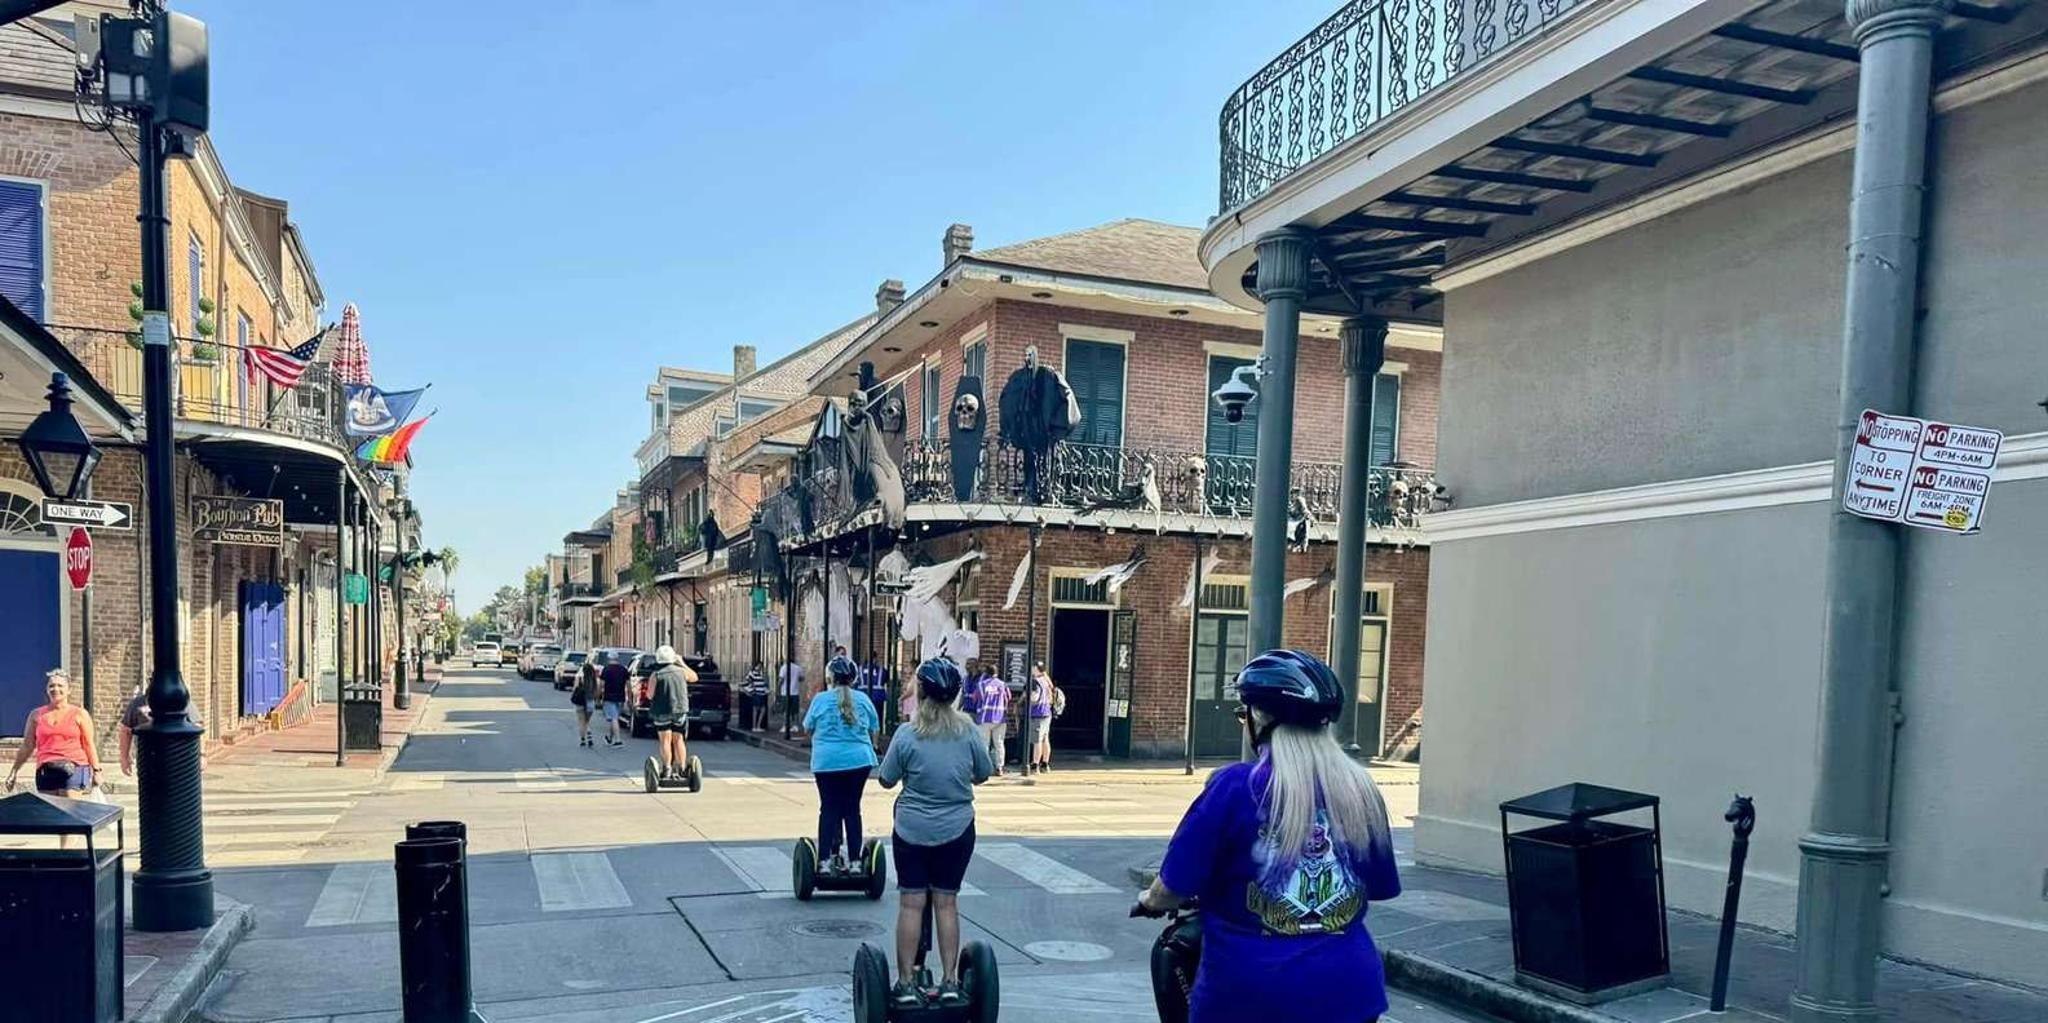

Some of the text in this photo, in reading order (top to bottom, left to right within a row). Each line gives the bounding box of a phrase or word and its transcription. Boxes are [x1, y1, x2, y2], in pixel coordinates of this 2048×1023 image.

[1861, 417, 1919, 444] NO STOPPING
[1926, 429, 1996, 448] NO PARKING
[1871, 451, 1887, 463] TO
[1934, 450, 1983, 464] 4PM-6AM
[1855, 462, 1903, 481] CORNER
[1915, 471, 1984, 491] NO PARKING
[1847, 492, 1898, 511] ANYTIME
[1917, 490, 1977, 505] FREIGHT ZONE
[51, 506, 103, 519] ONE WAY
[195, 500, 281, 527] Bourbon Pub
[68, 547, 90, 570] STOP
